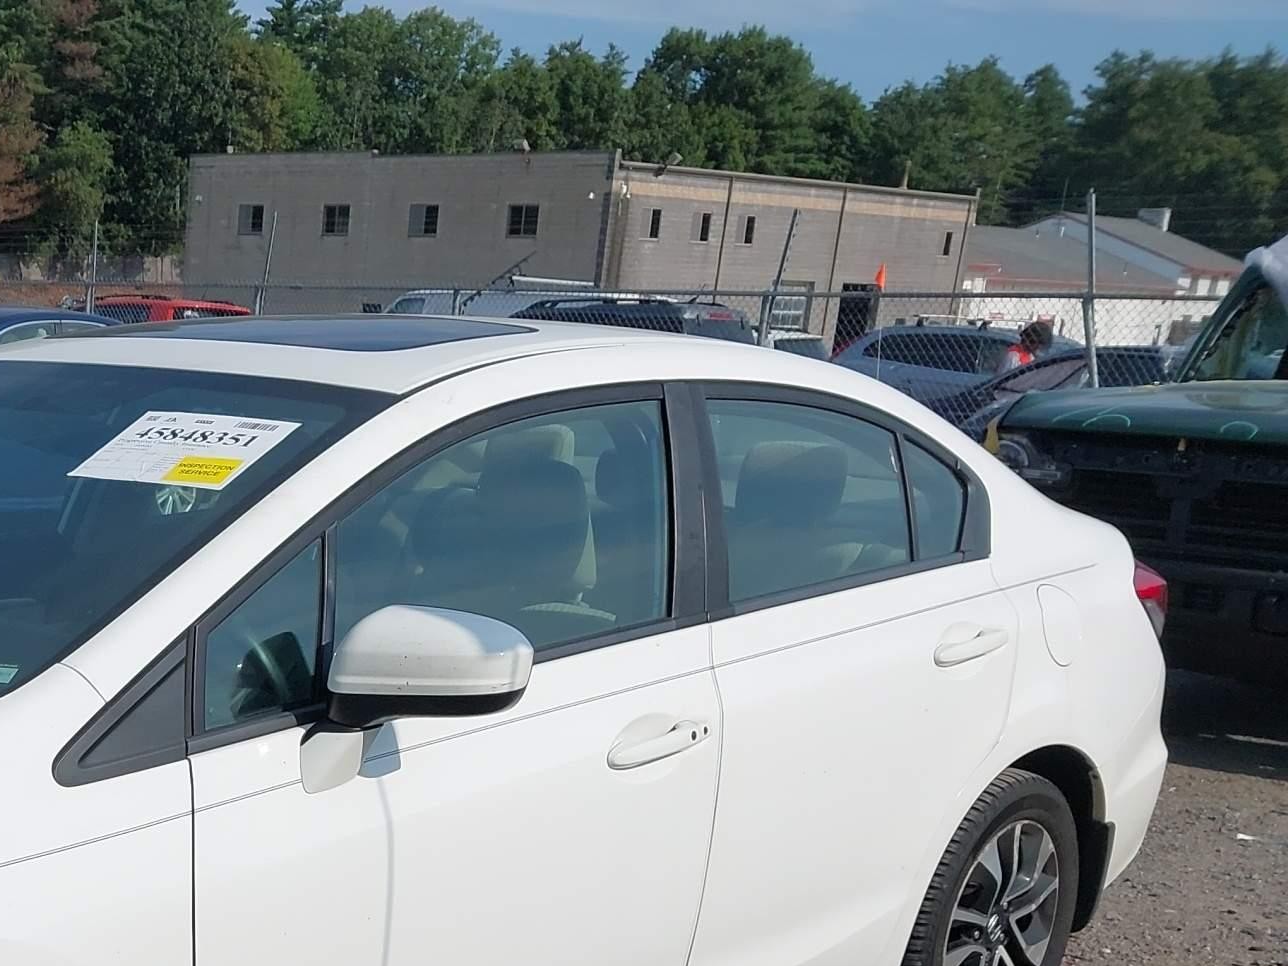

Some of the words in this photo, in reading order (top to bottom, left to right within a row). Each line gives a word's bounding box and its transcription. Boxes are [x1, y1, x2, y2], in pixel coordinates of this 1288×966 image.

[135, 426, 259, 447] 45848351
[178, 463, 235, 471] INSPECTION
[178, 469, 221, 477] SERVICE
